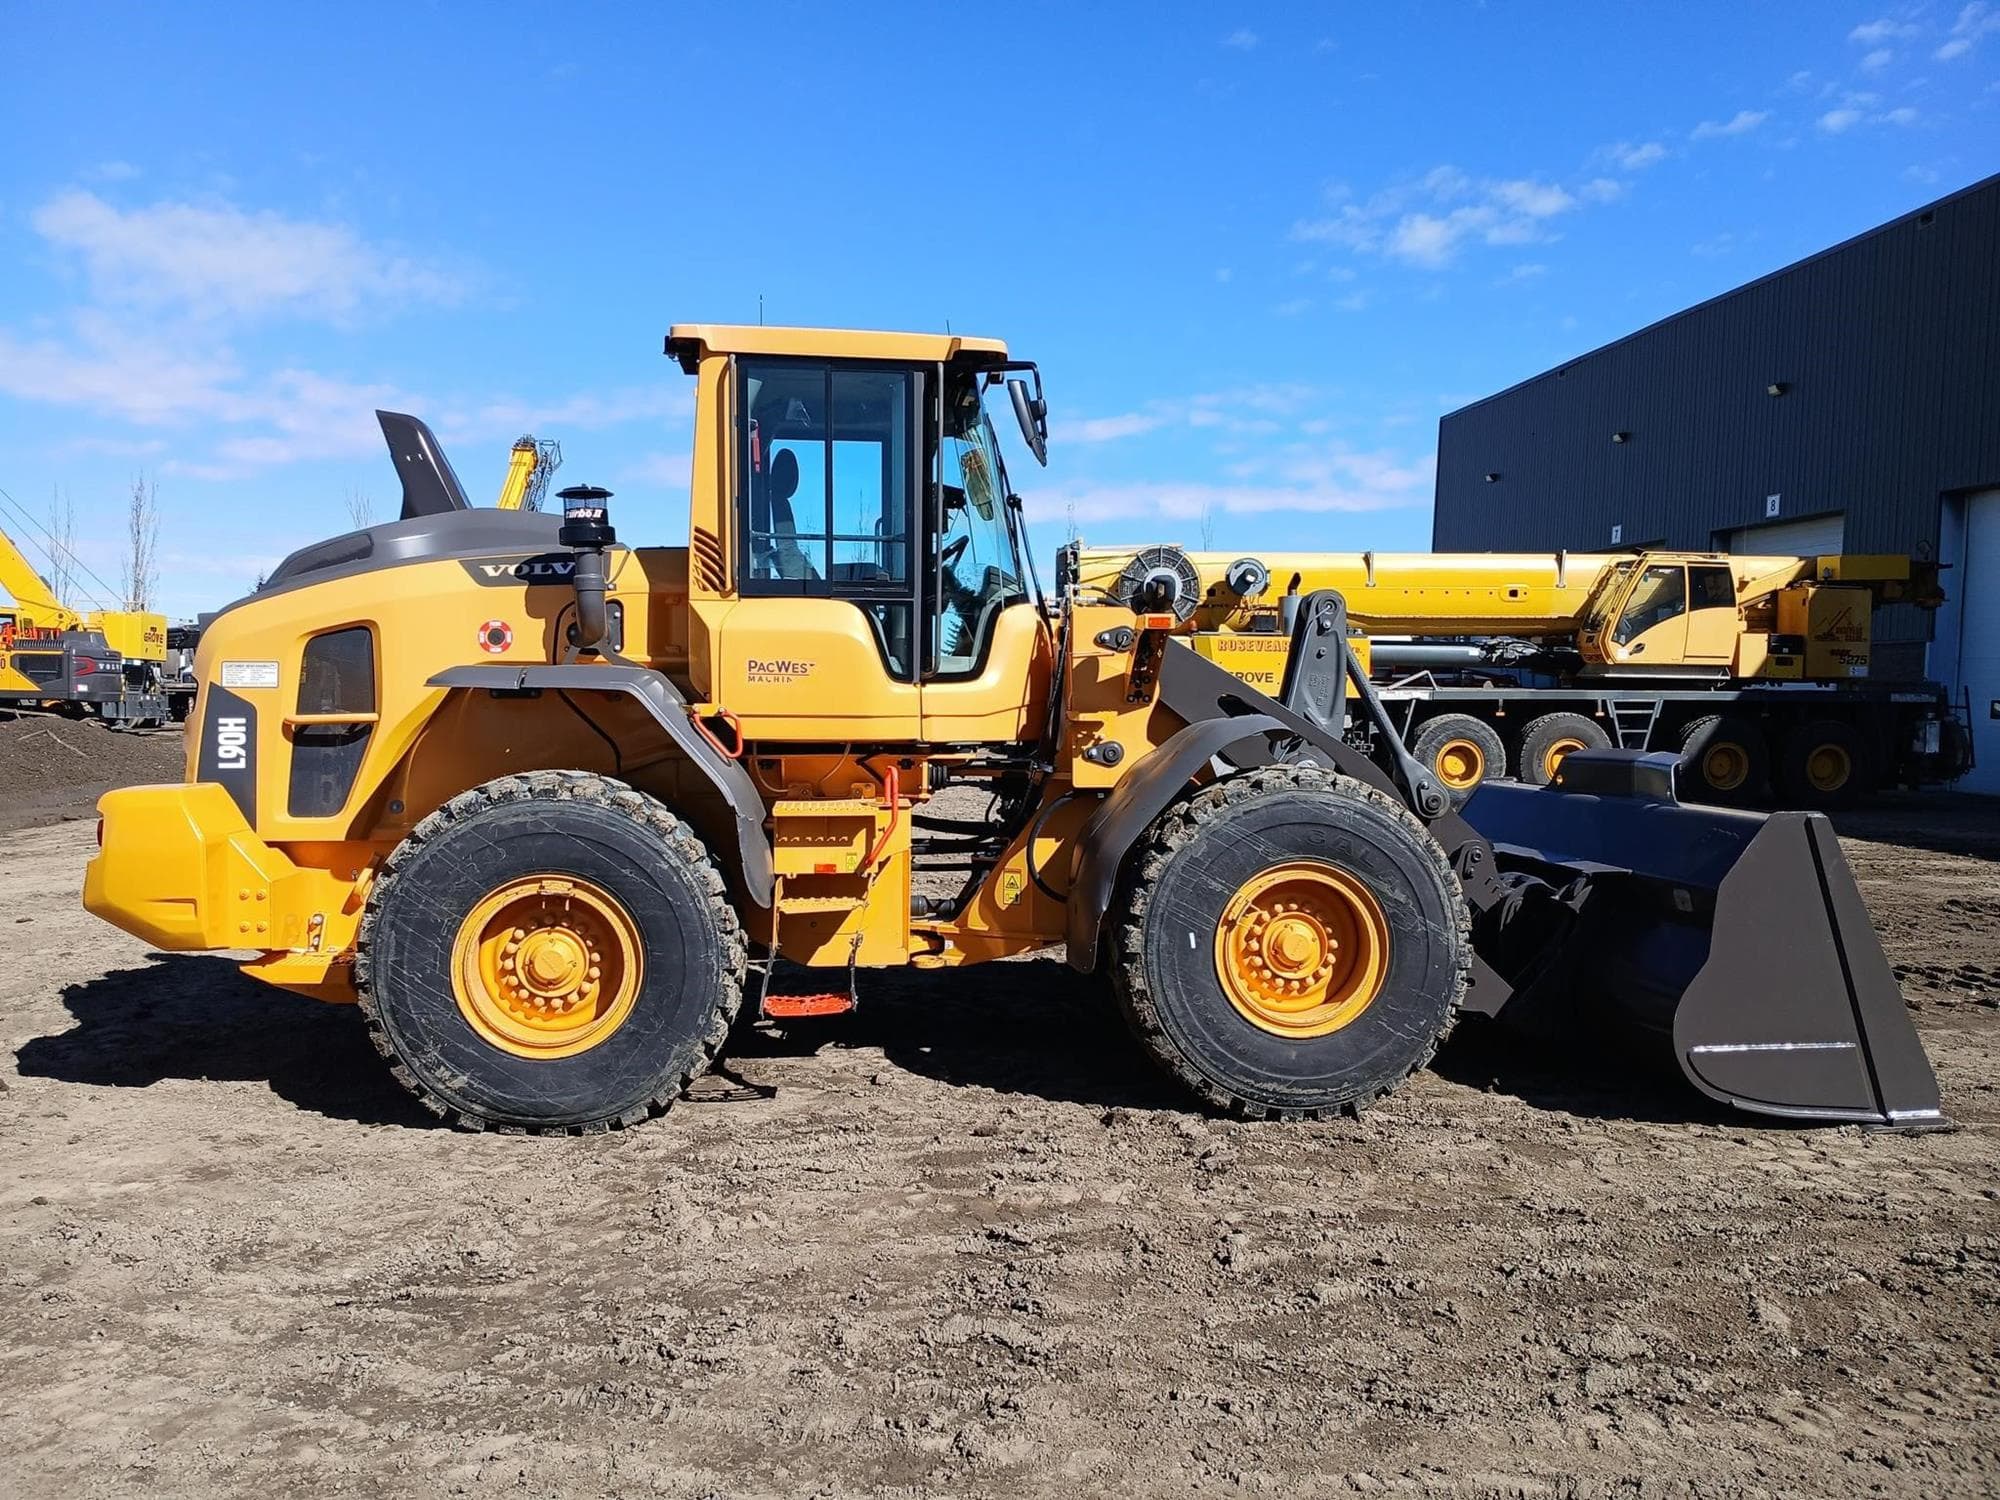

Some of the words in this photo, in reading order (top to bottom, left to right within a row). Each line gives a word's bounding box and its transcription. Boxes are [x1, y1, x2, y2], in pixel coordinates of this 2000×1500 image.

[479, 562, 576, 577] VOLV
[1218, 639, 1290, 653] ROSEVEAR
[1839, 655, 1868, 665] 5275
[1229, 671, 1274, 683] ROVE
[217, 717, 247, 769] L90H
